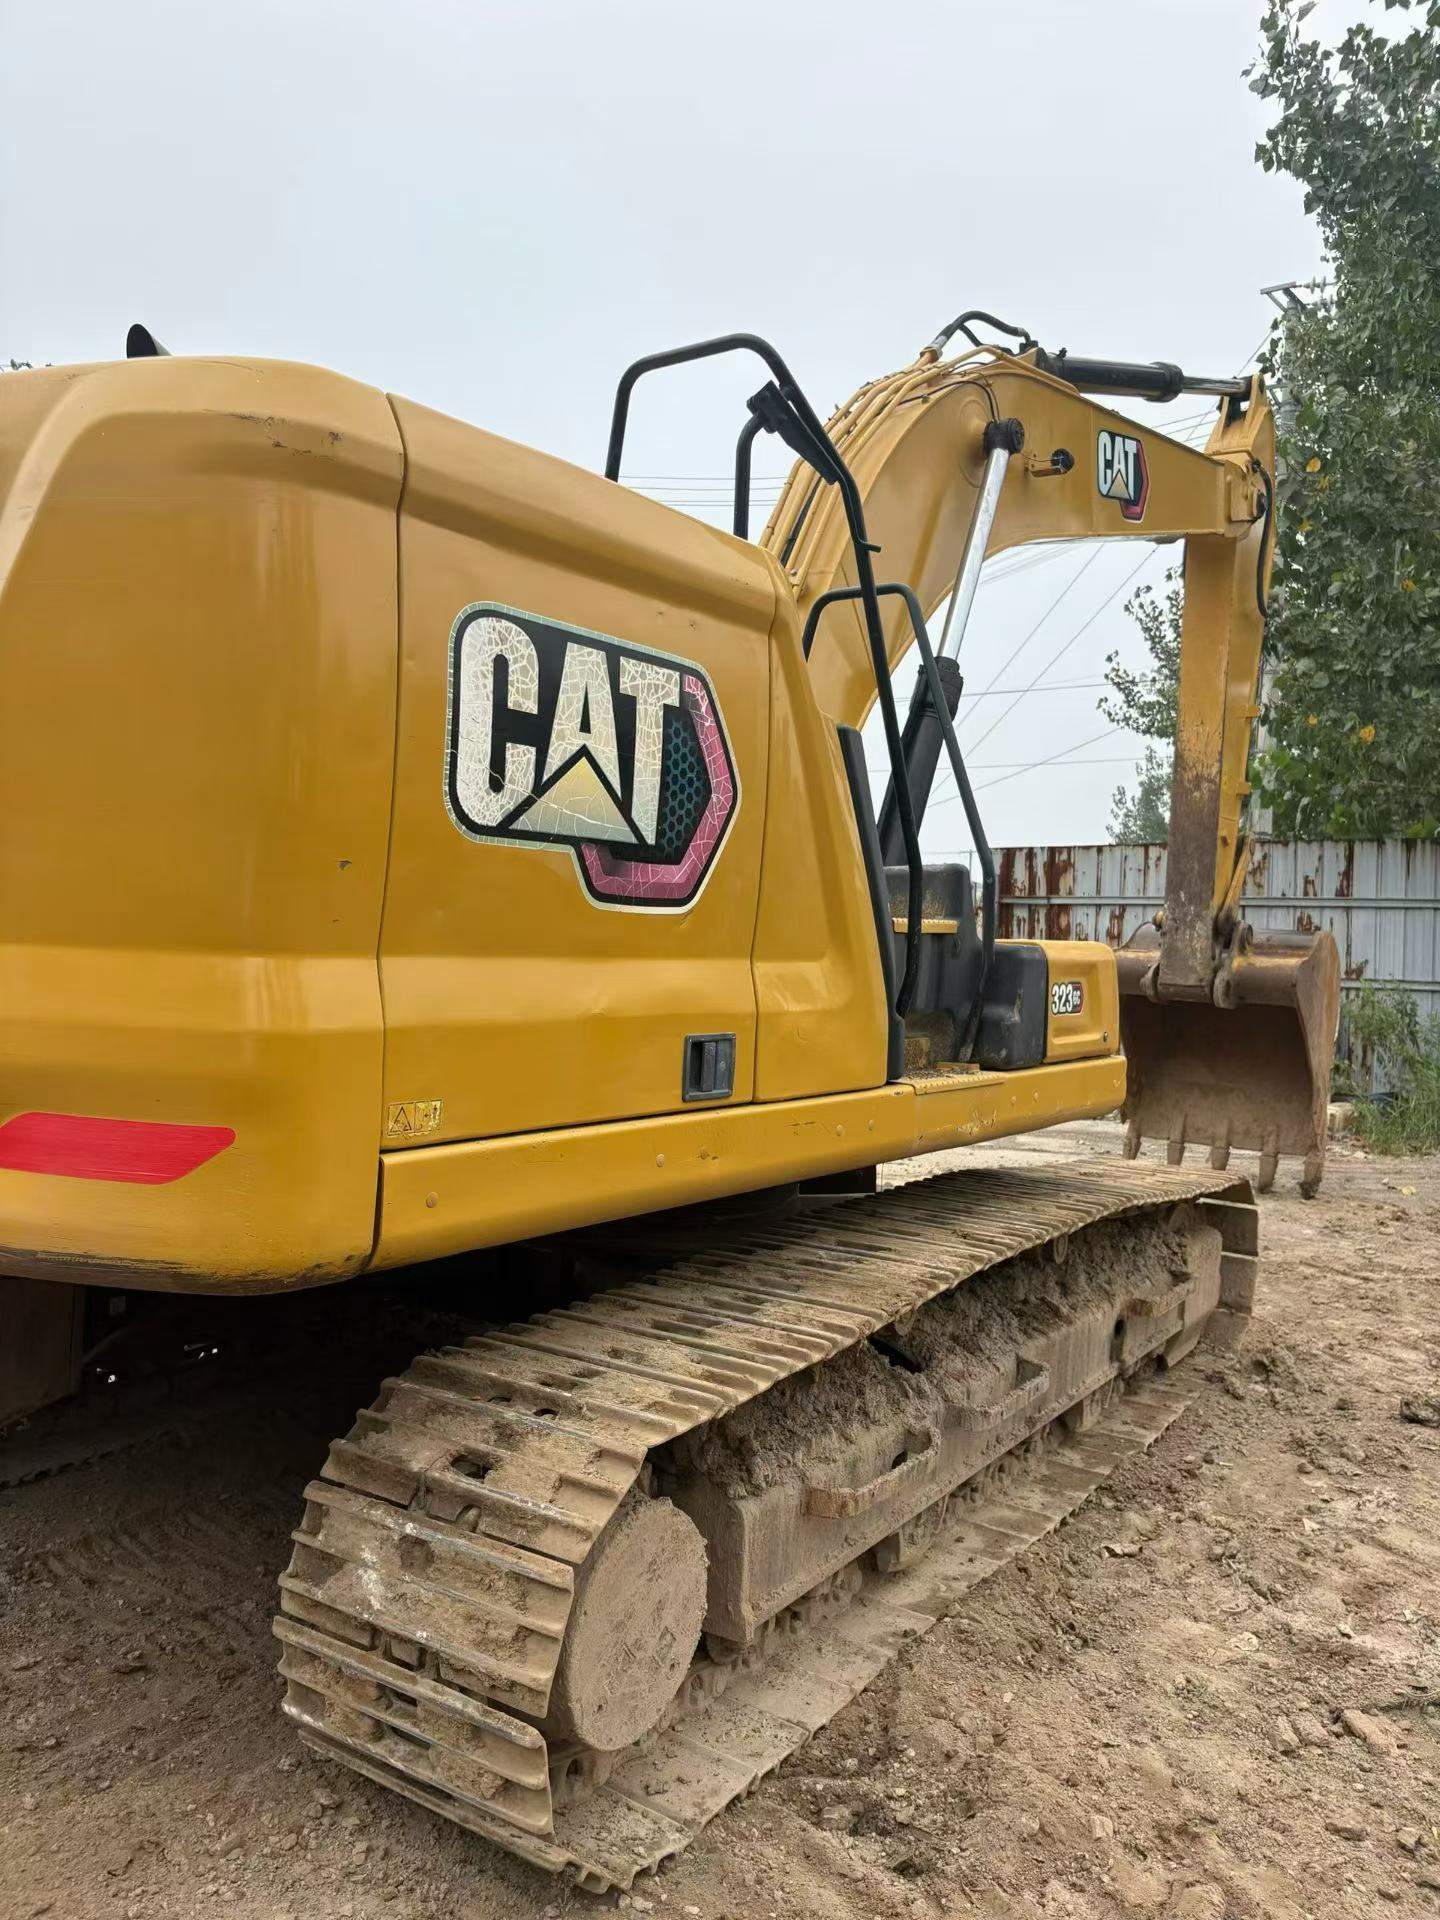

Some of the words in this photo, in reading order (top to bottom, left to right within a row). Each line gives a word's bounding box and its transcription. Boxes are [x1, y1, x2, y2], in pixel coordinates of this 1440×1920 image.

[1098, 431, 1137, 501] CAT
[455, 616, 680, 846] CAT
[1052, 983, 1073, 1014] 323
